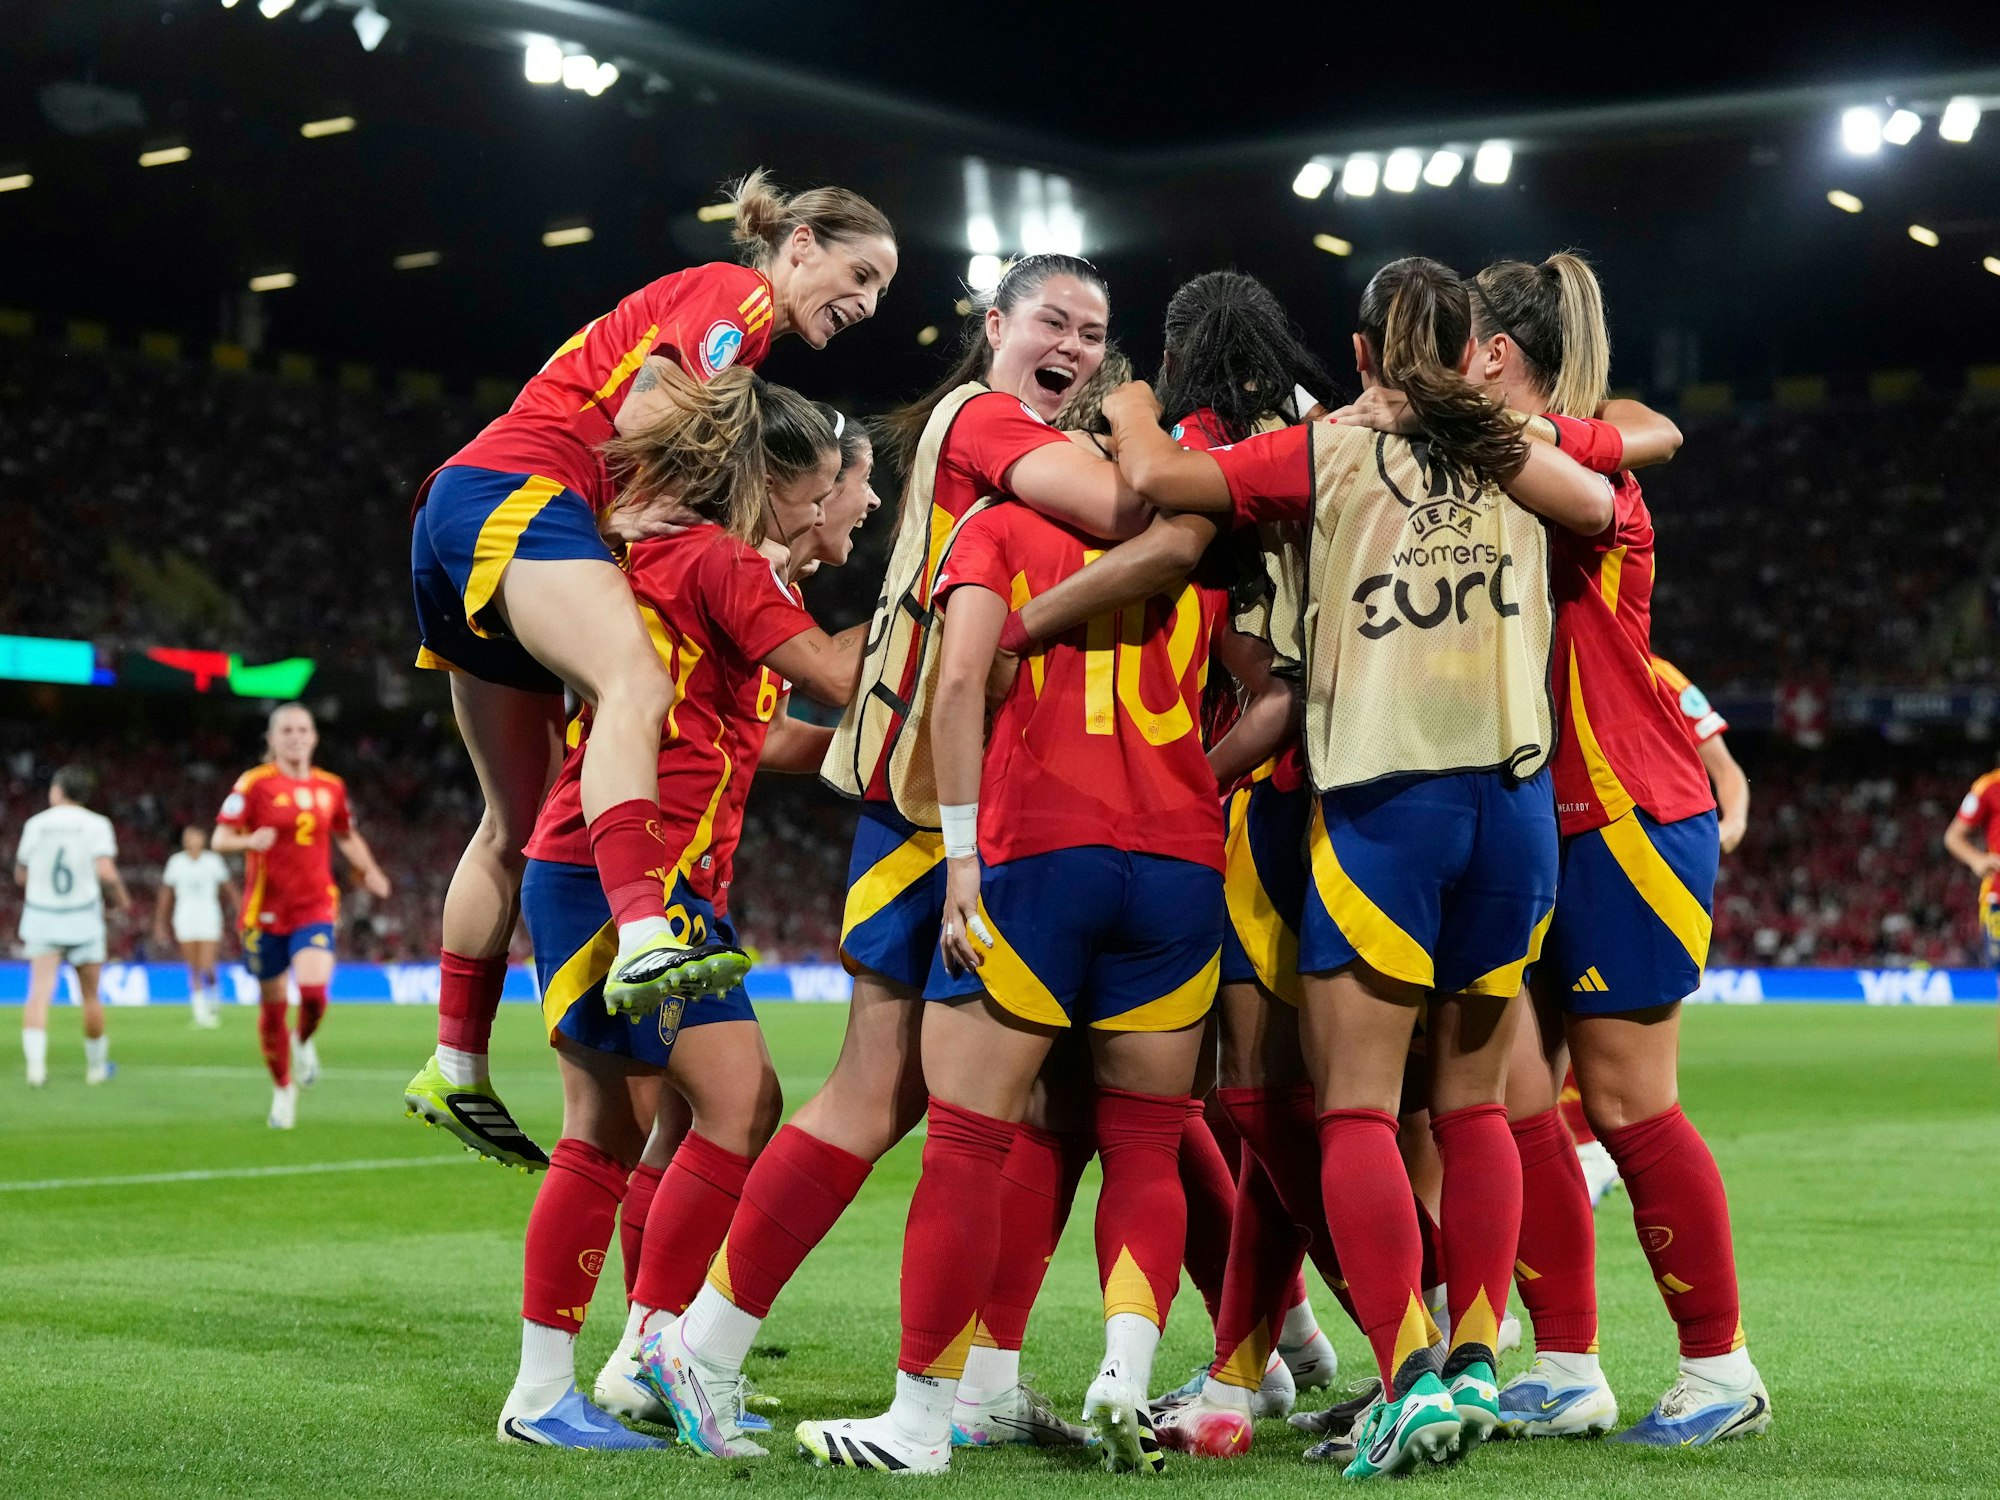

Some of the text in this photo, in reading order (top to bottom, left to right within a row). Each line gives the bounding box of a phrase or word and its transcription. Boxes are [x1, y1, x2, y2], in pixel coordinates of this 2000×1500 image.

[1412, 506, 1473, 535] UEFA
[1083, 550, 1201, 747] 10
[295, 811, 316, 846] 2
[52, 845, 74, 896] 6
[1857, 968, 1954, 1006] VISA
